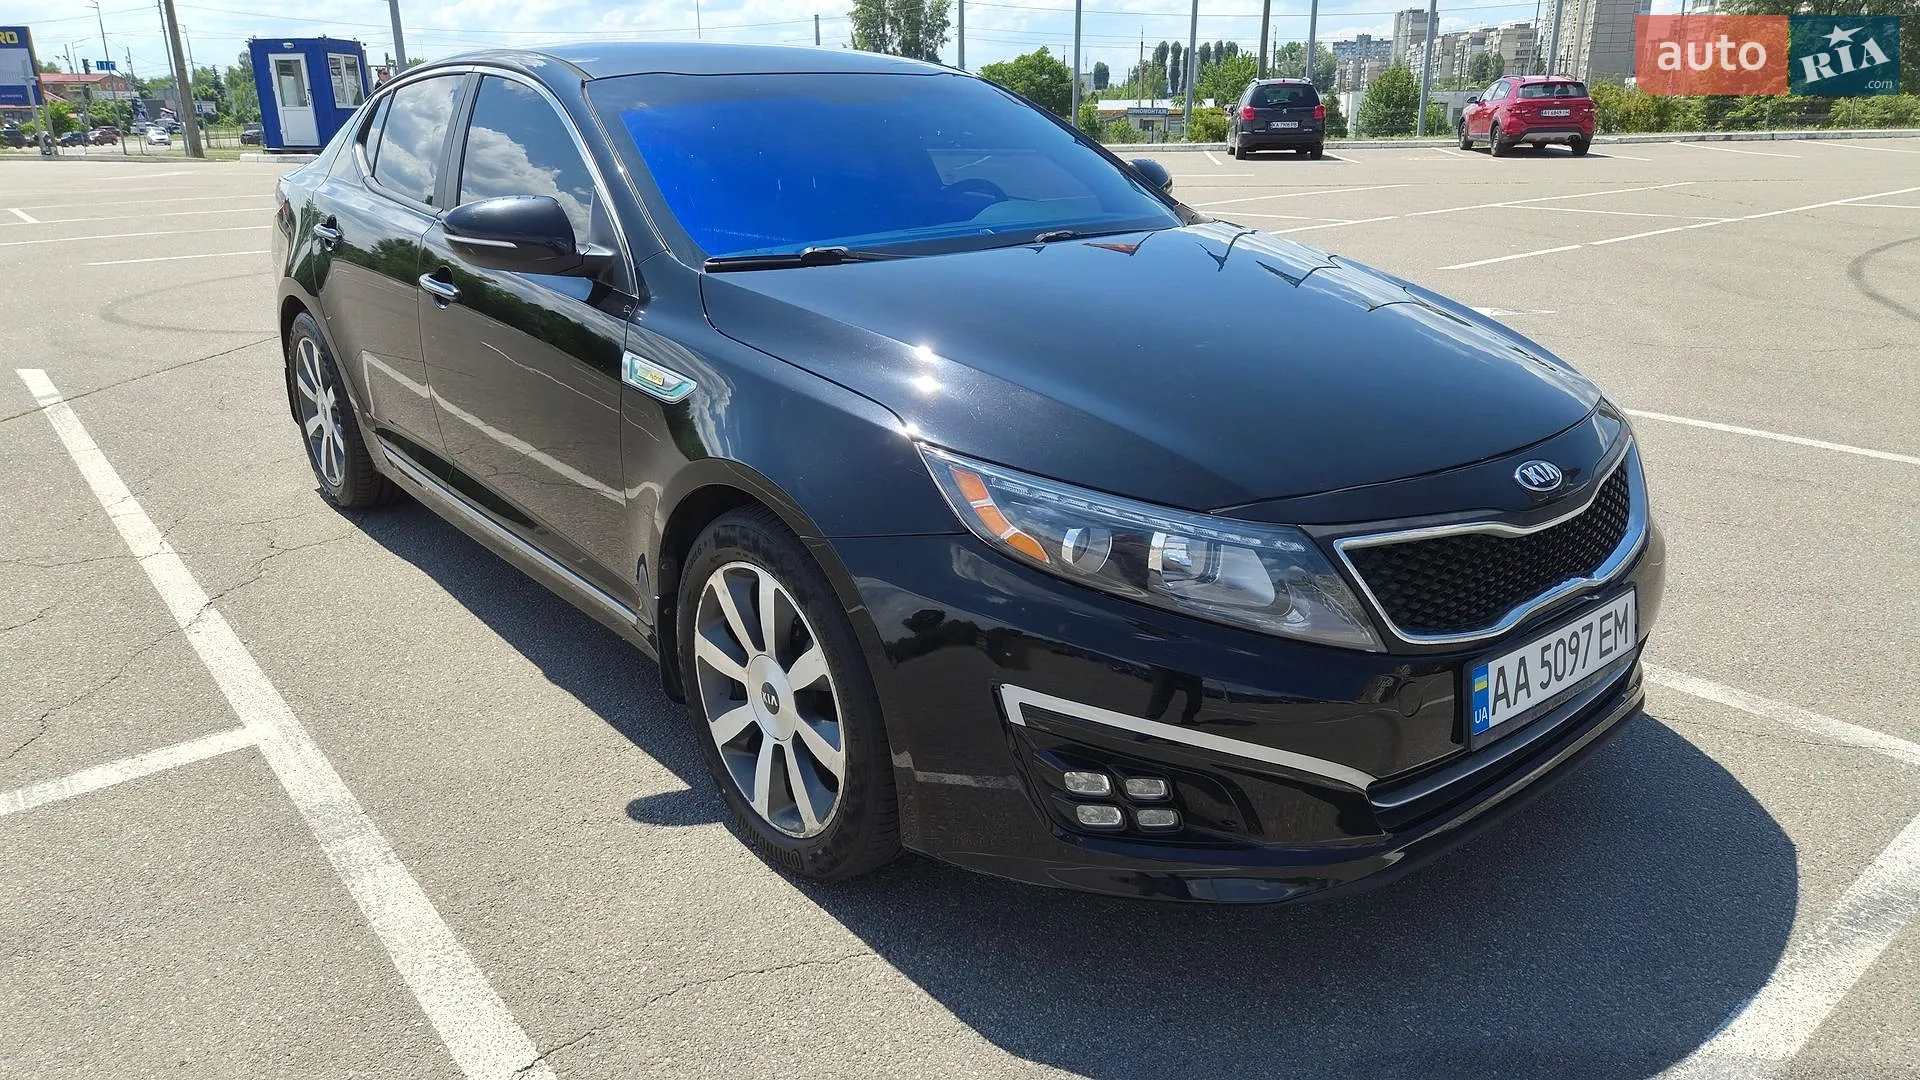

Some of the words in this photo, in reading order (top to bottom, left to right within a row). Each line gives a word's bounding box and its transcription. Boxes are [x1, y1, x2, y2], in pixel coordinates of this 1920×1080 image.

[1521, 463, 1559, 485] KIA
[1491, 656, 1532, 716] AA
[1539, 622, 1594, 690] 5097
[1599, 602, 1629, 660] EM
[762, 692, 778, 706] KIA
[1474, 708, 1488, 724] UA
